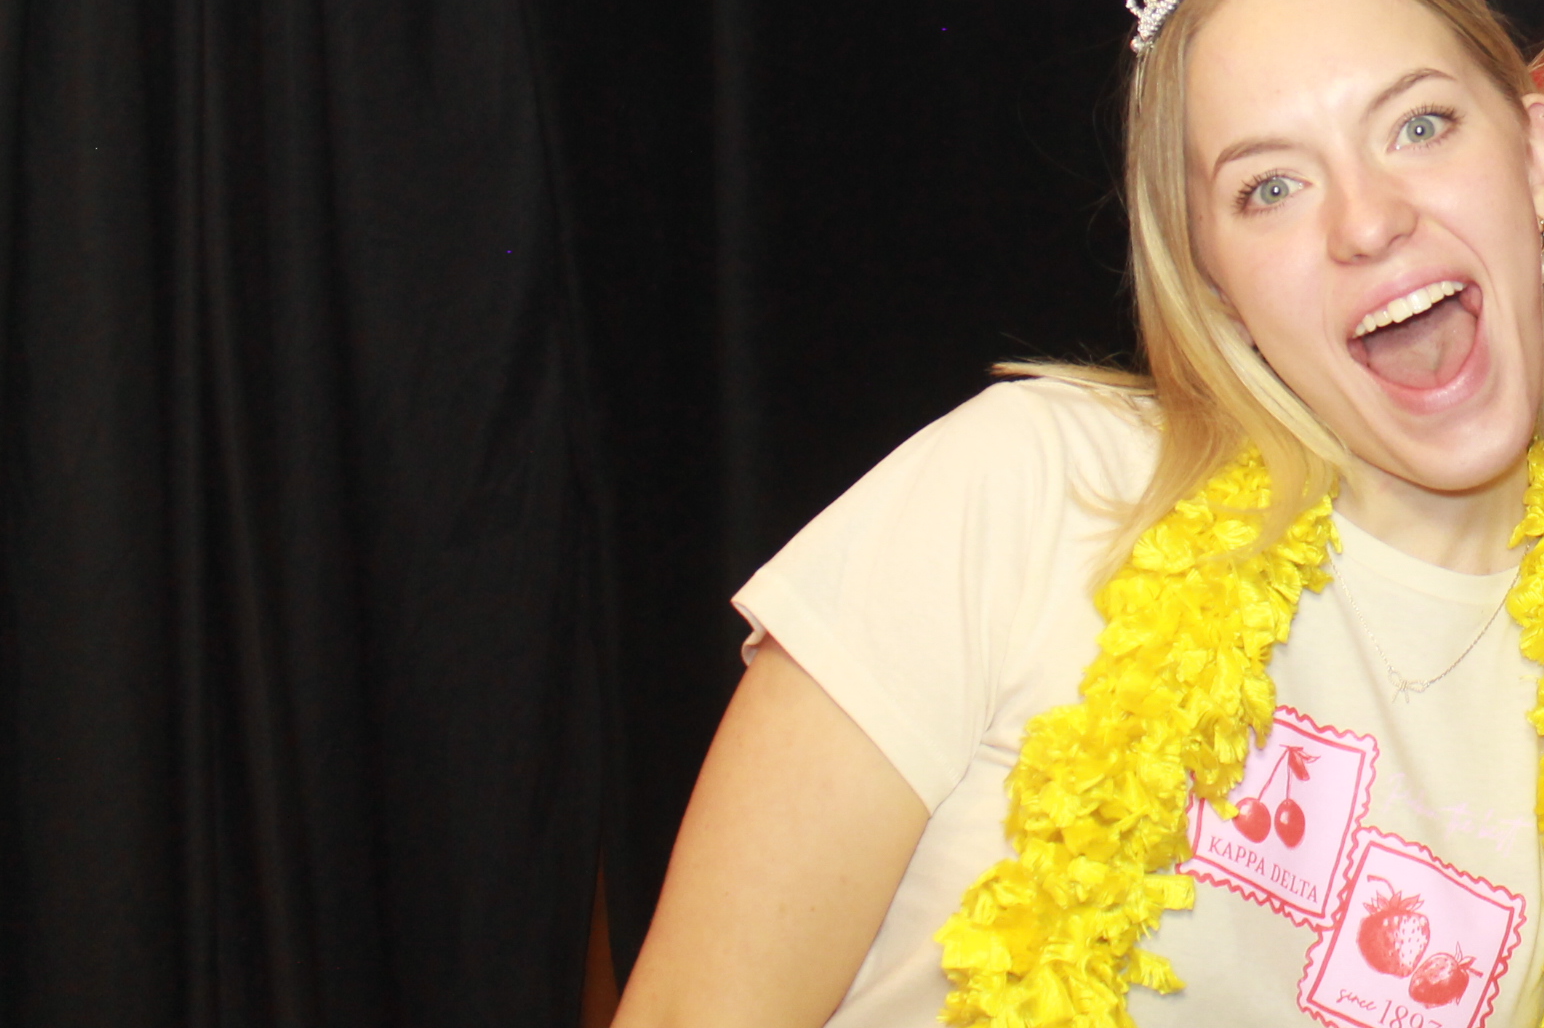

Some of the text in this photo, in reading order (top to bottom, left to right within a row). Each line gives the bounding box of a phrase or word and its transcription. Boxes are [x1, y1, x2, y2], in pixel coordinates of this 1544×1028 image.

[1208, 835, 1319, 903] KAPPA DELTA
[1336, 988, 1377, 1011] since
